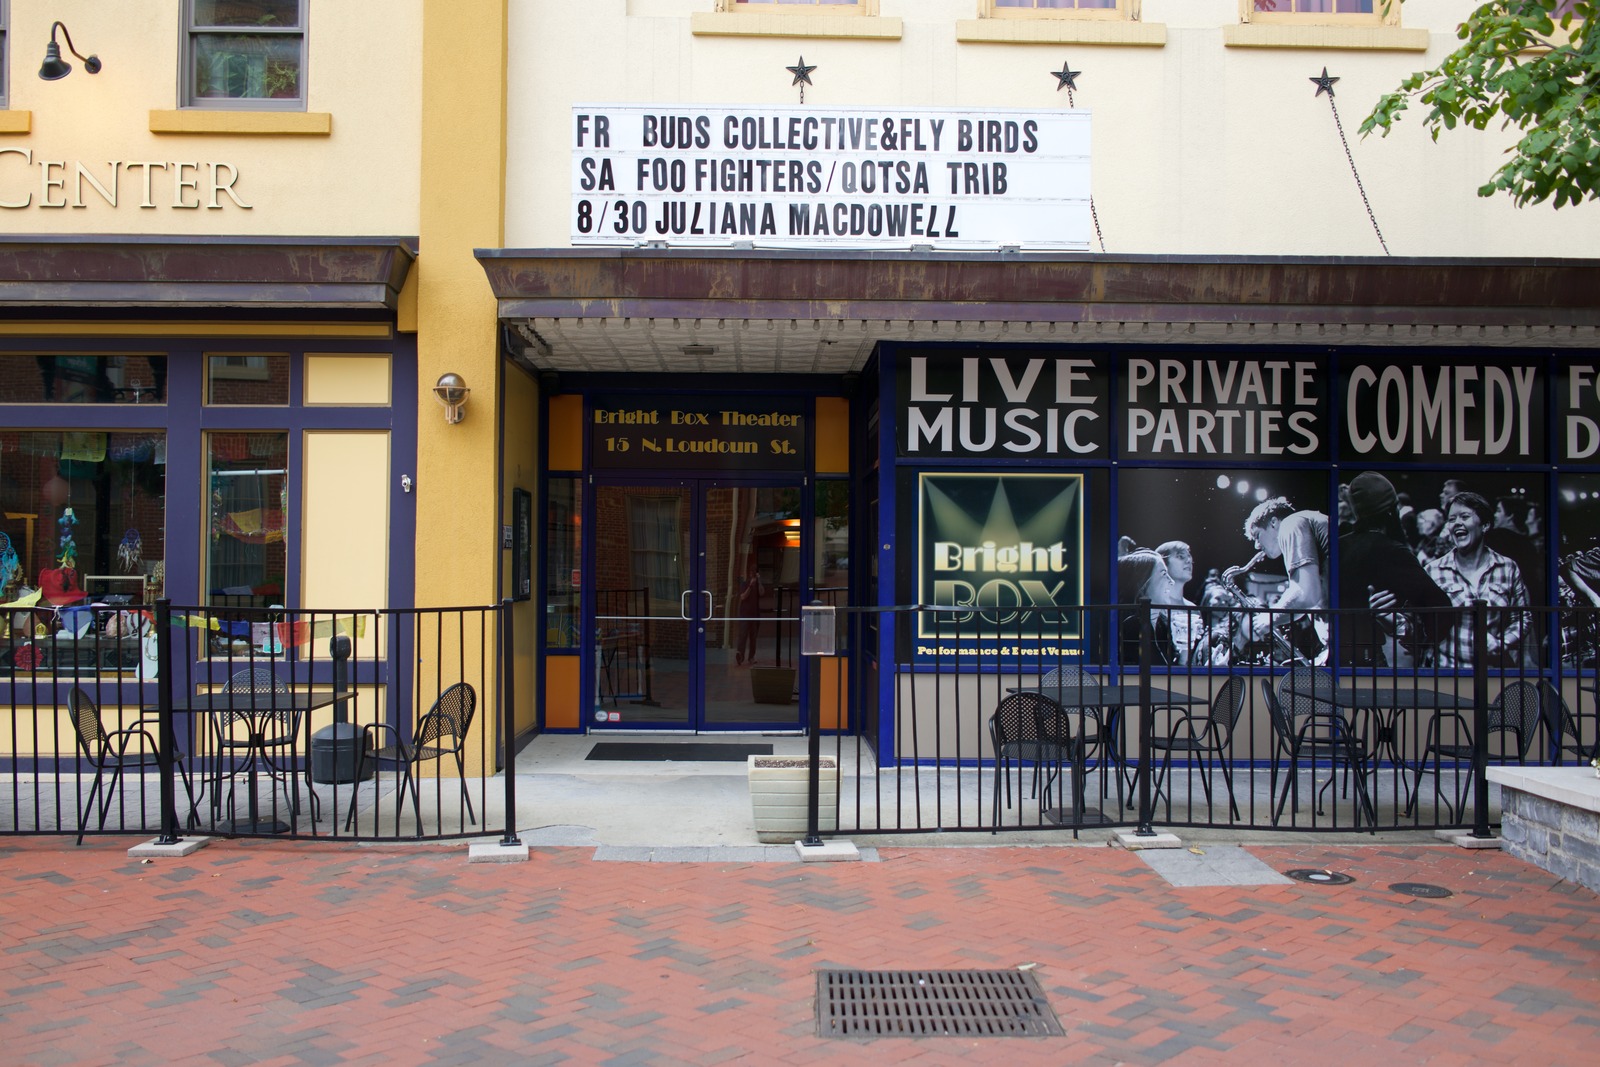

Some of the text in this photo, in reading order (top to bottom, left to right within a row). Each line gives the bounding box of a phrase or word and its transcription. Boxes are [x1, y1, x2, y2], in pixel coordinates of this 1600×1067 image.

[577, 115, 1038, 153] FR BUDS COLLECTIVE&FLY BIRDS
[580, 157, 1008, 195] SA FOO FIGHTERS/QOTSA TRIB
[577, 199, 959, 237] 8/30 JULIANA MACDOWELL
[910, 357, 1098, 404] LIVE
[1128, 359, 1319, 406] PRIVATE
[1569, 365, 1600, 409] F
[594, 409, 802, 427] Bright Box Theater
[1346, 364, 1536, 456] COMEDY
[605, 437, 630, 452] 15
[770, 439, 797, 455] St.
[907, 407, 1099, 453] MUSIC
[1128, 408, 1319, 455] PARTIES
[934, 540, 1068, 573] Bright
[1000, 646, 1009, 656] &
